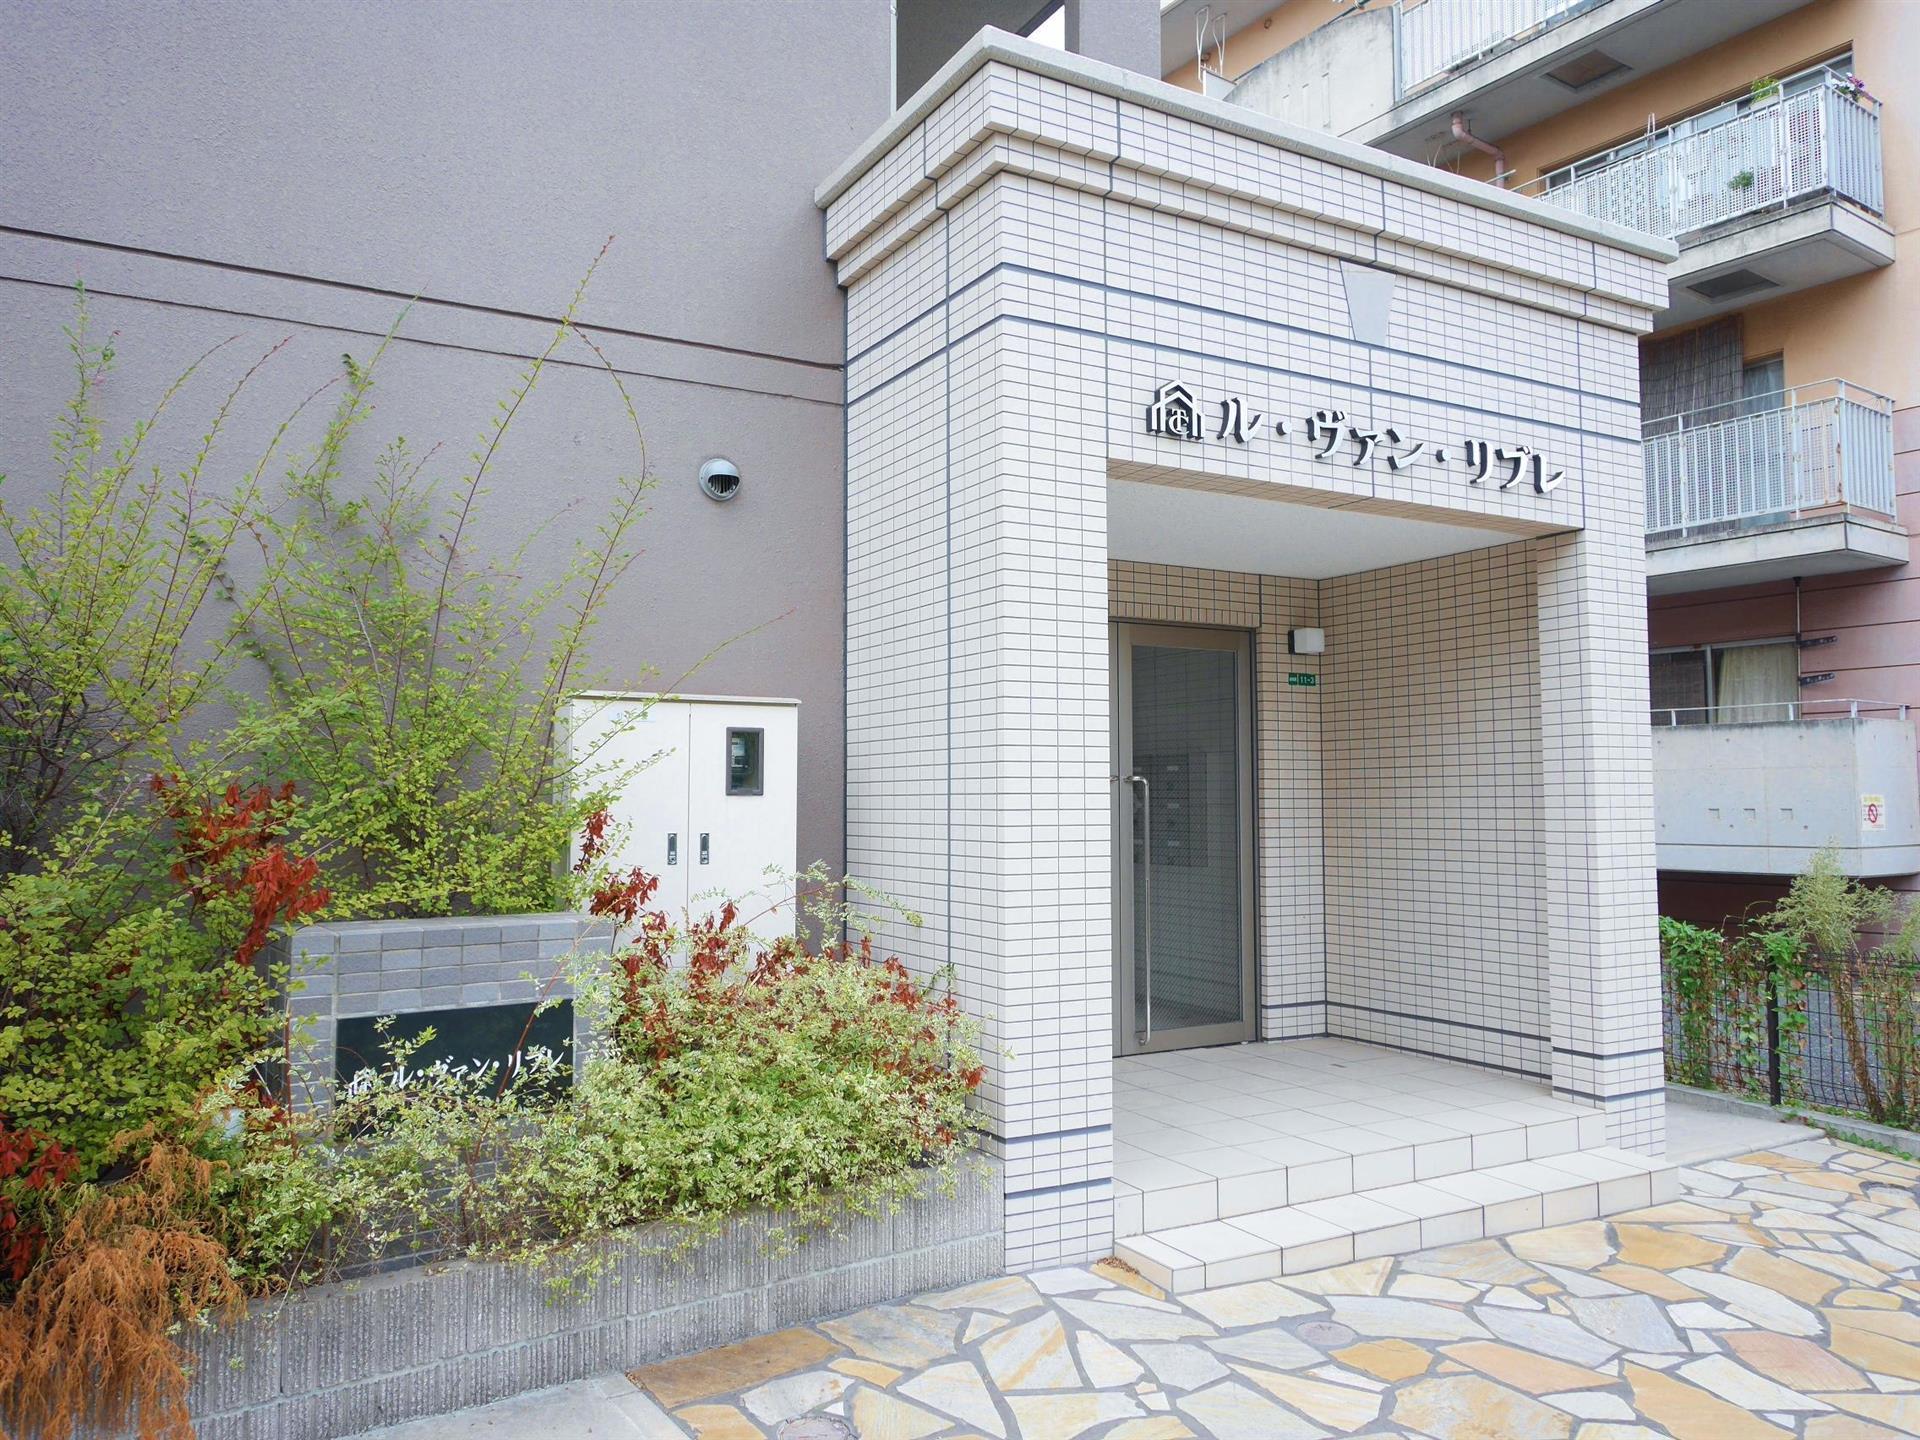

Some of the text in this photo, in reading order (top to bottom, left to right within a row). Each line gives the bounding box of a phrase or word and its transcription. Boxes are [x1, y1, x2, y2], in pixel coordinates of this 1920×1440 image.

[1217, 397, 1566, 494] ル・ヴァン・リブレ
